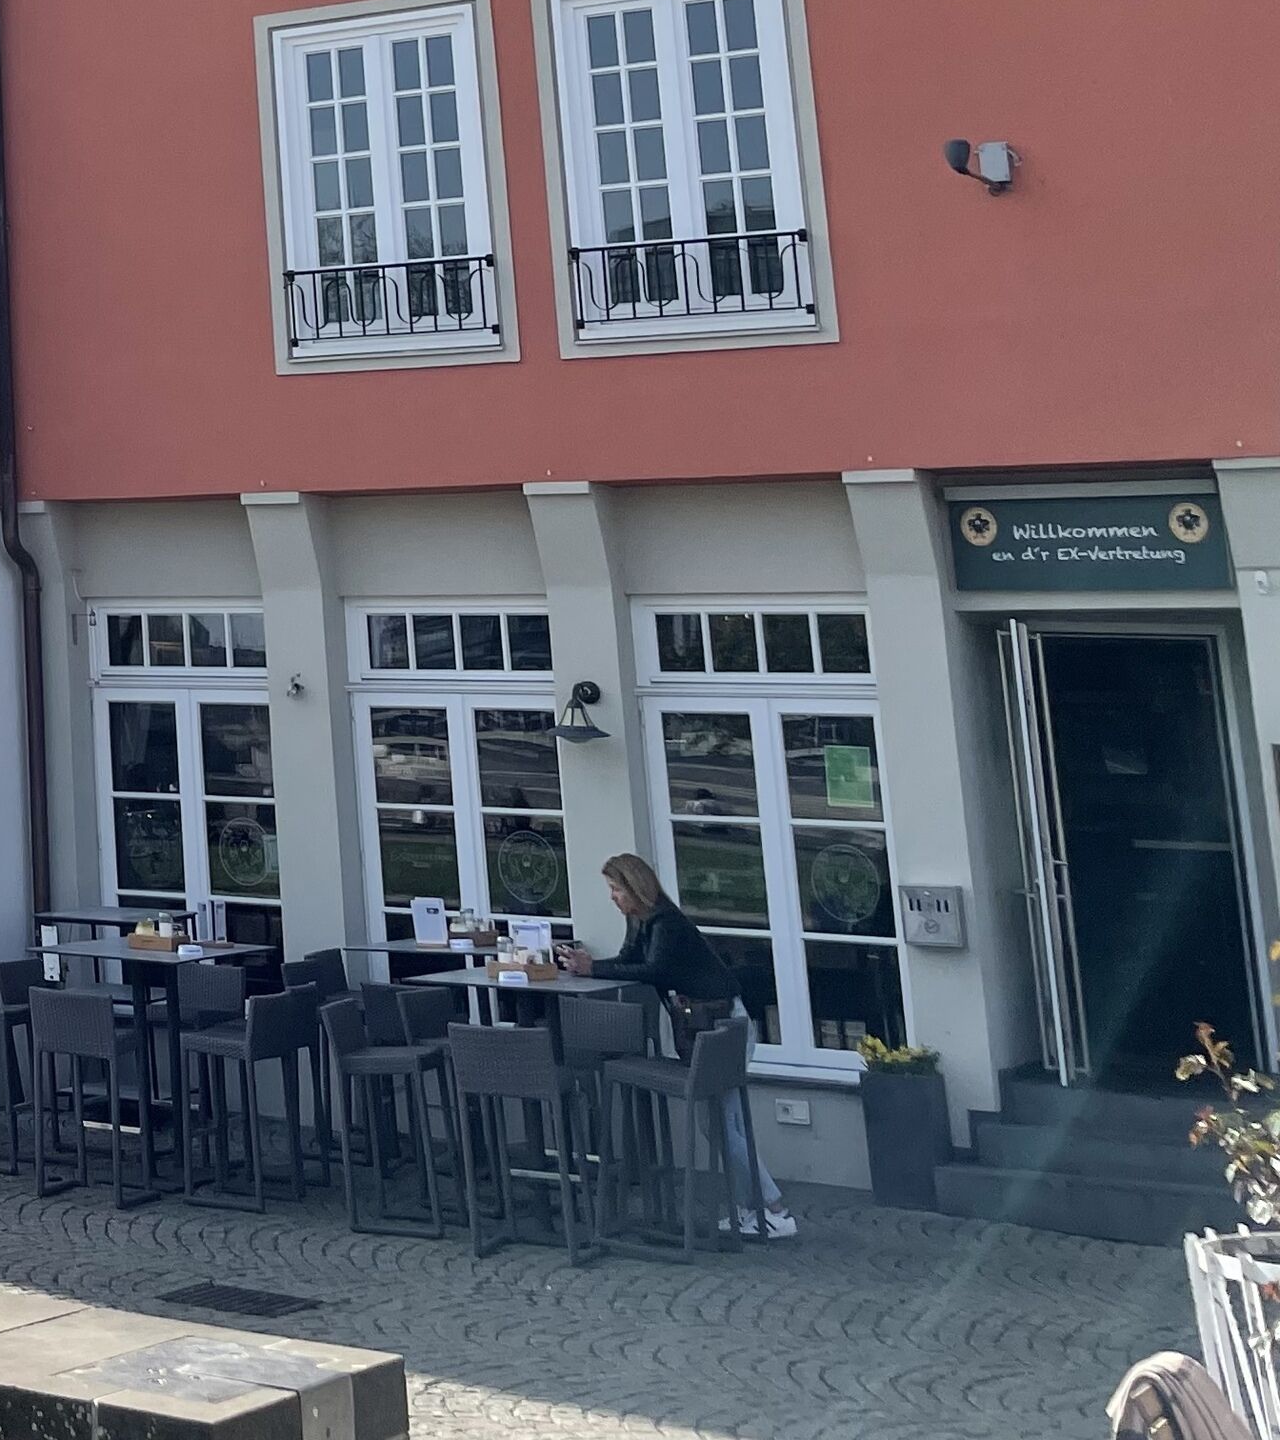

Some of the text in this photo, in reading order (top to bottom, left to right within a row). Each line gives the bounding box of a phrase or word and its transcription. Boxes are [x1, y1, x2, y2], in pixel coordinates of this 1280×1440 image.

[1012, 523, 1158, 541] Willkommen
[991, 551, 1016, 562] en
[1057, 545, 1186, 565] EX-Vertretung
